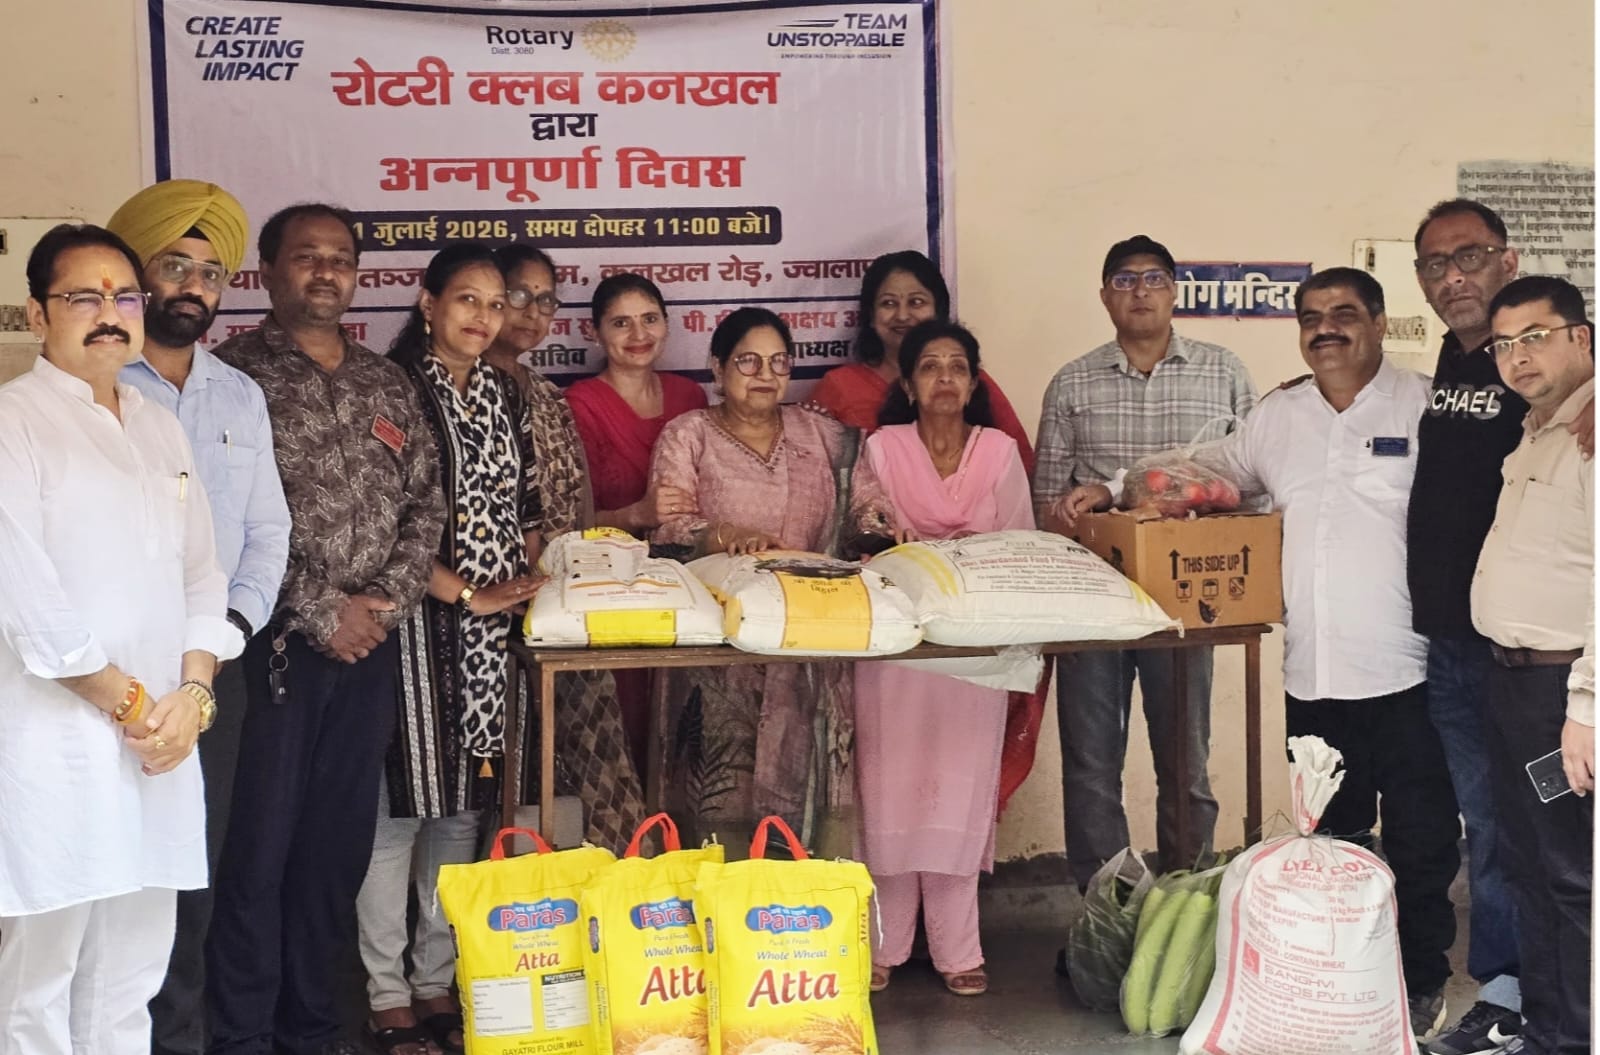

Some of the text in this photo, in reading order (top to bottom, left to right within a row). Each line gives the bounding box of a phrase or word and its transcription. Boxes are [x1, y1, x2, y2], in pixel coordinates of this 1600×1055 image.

[185, 16, 281, 35] CREATE
[844, 13, 907, 29] TEAM
[486, 26, 573, 50] Rotary
[767, 32, 905, 47] UNSTOPPABLE
[195, 40, 304, 59] LASTING
[202, 62, 299, 81] IMPACT
[331, 56, 781, 107] रोटरी क्लब कनखल
[529, 113, 598, 140] द्वारा
[379, 145, 745, 202] अन्नपूर्णा दिवस
[372, 215, 438, 246] जुलाई
[446, 219, 517, 242] 2026,
[525, 218, 577, 238] समय
[583, 213, 645, 238] दोपहर
[654, 217, 720, 235] 11:00
[529, 344, 587, 367] सचिव
[1182, 554, 1240, 573] THIS SIDE UP
[500, 907, 565, 929] Paras
[758, 910, 821, 929] Paras
[644, 946, 673, 957] Whole
[757, 949, 827, 960] Whole Wheat
[515, 952, 560, 973] Atta
[1264, 963, 1335, 990] SANGHVI
[1264, 976, 1313, 998] FOODS
[748, 969, 839, 1007] Atta
[537, 1041, 565, 1053] FLOUR
